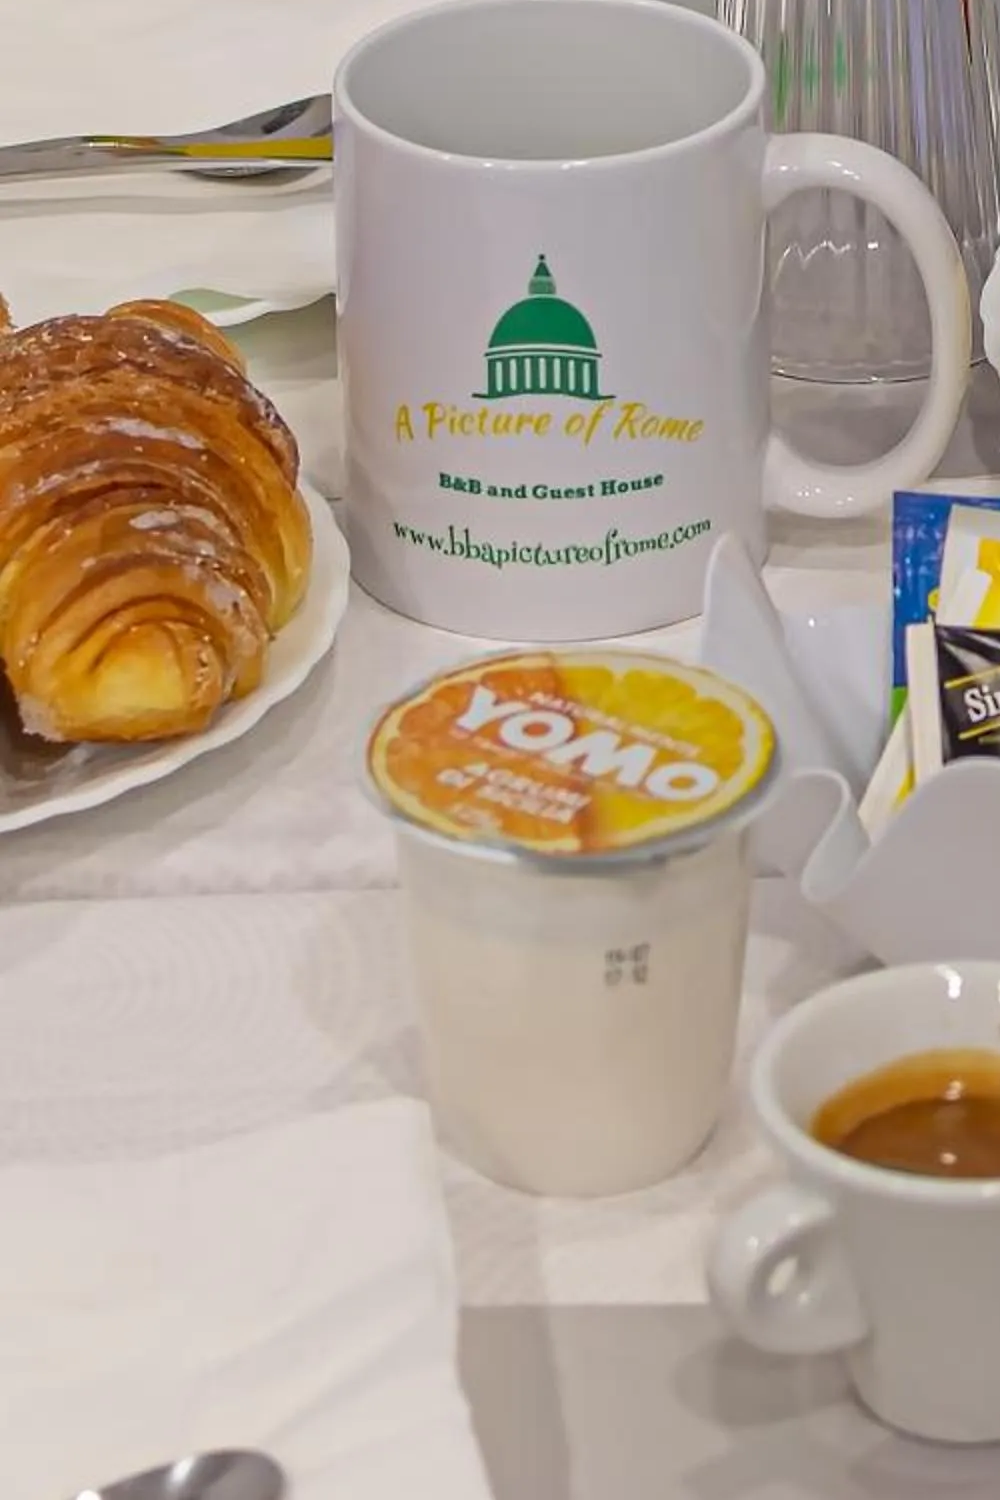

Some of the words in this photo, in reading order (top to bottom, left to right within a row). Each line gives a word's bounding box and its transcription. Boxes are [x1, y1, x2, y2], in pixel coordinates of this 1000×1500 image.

[394, 404, 414, 442] A
[422, 402, 552, 440] Picture
[564, 399, 613, 447] of
[612, 401, 704, 443] Rome
[439, 472, 482, 495] B&B
[487, 483, 527, 499] and
[532, 484, 595, 500] Guest
[600, 472, 664, 496] House
[393, 518, 711, 569] www.bbapictureofrome.com
[454, 684, 719, 800] YOMO
